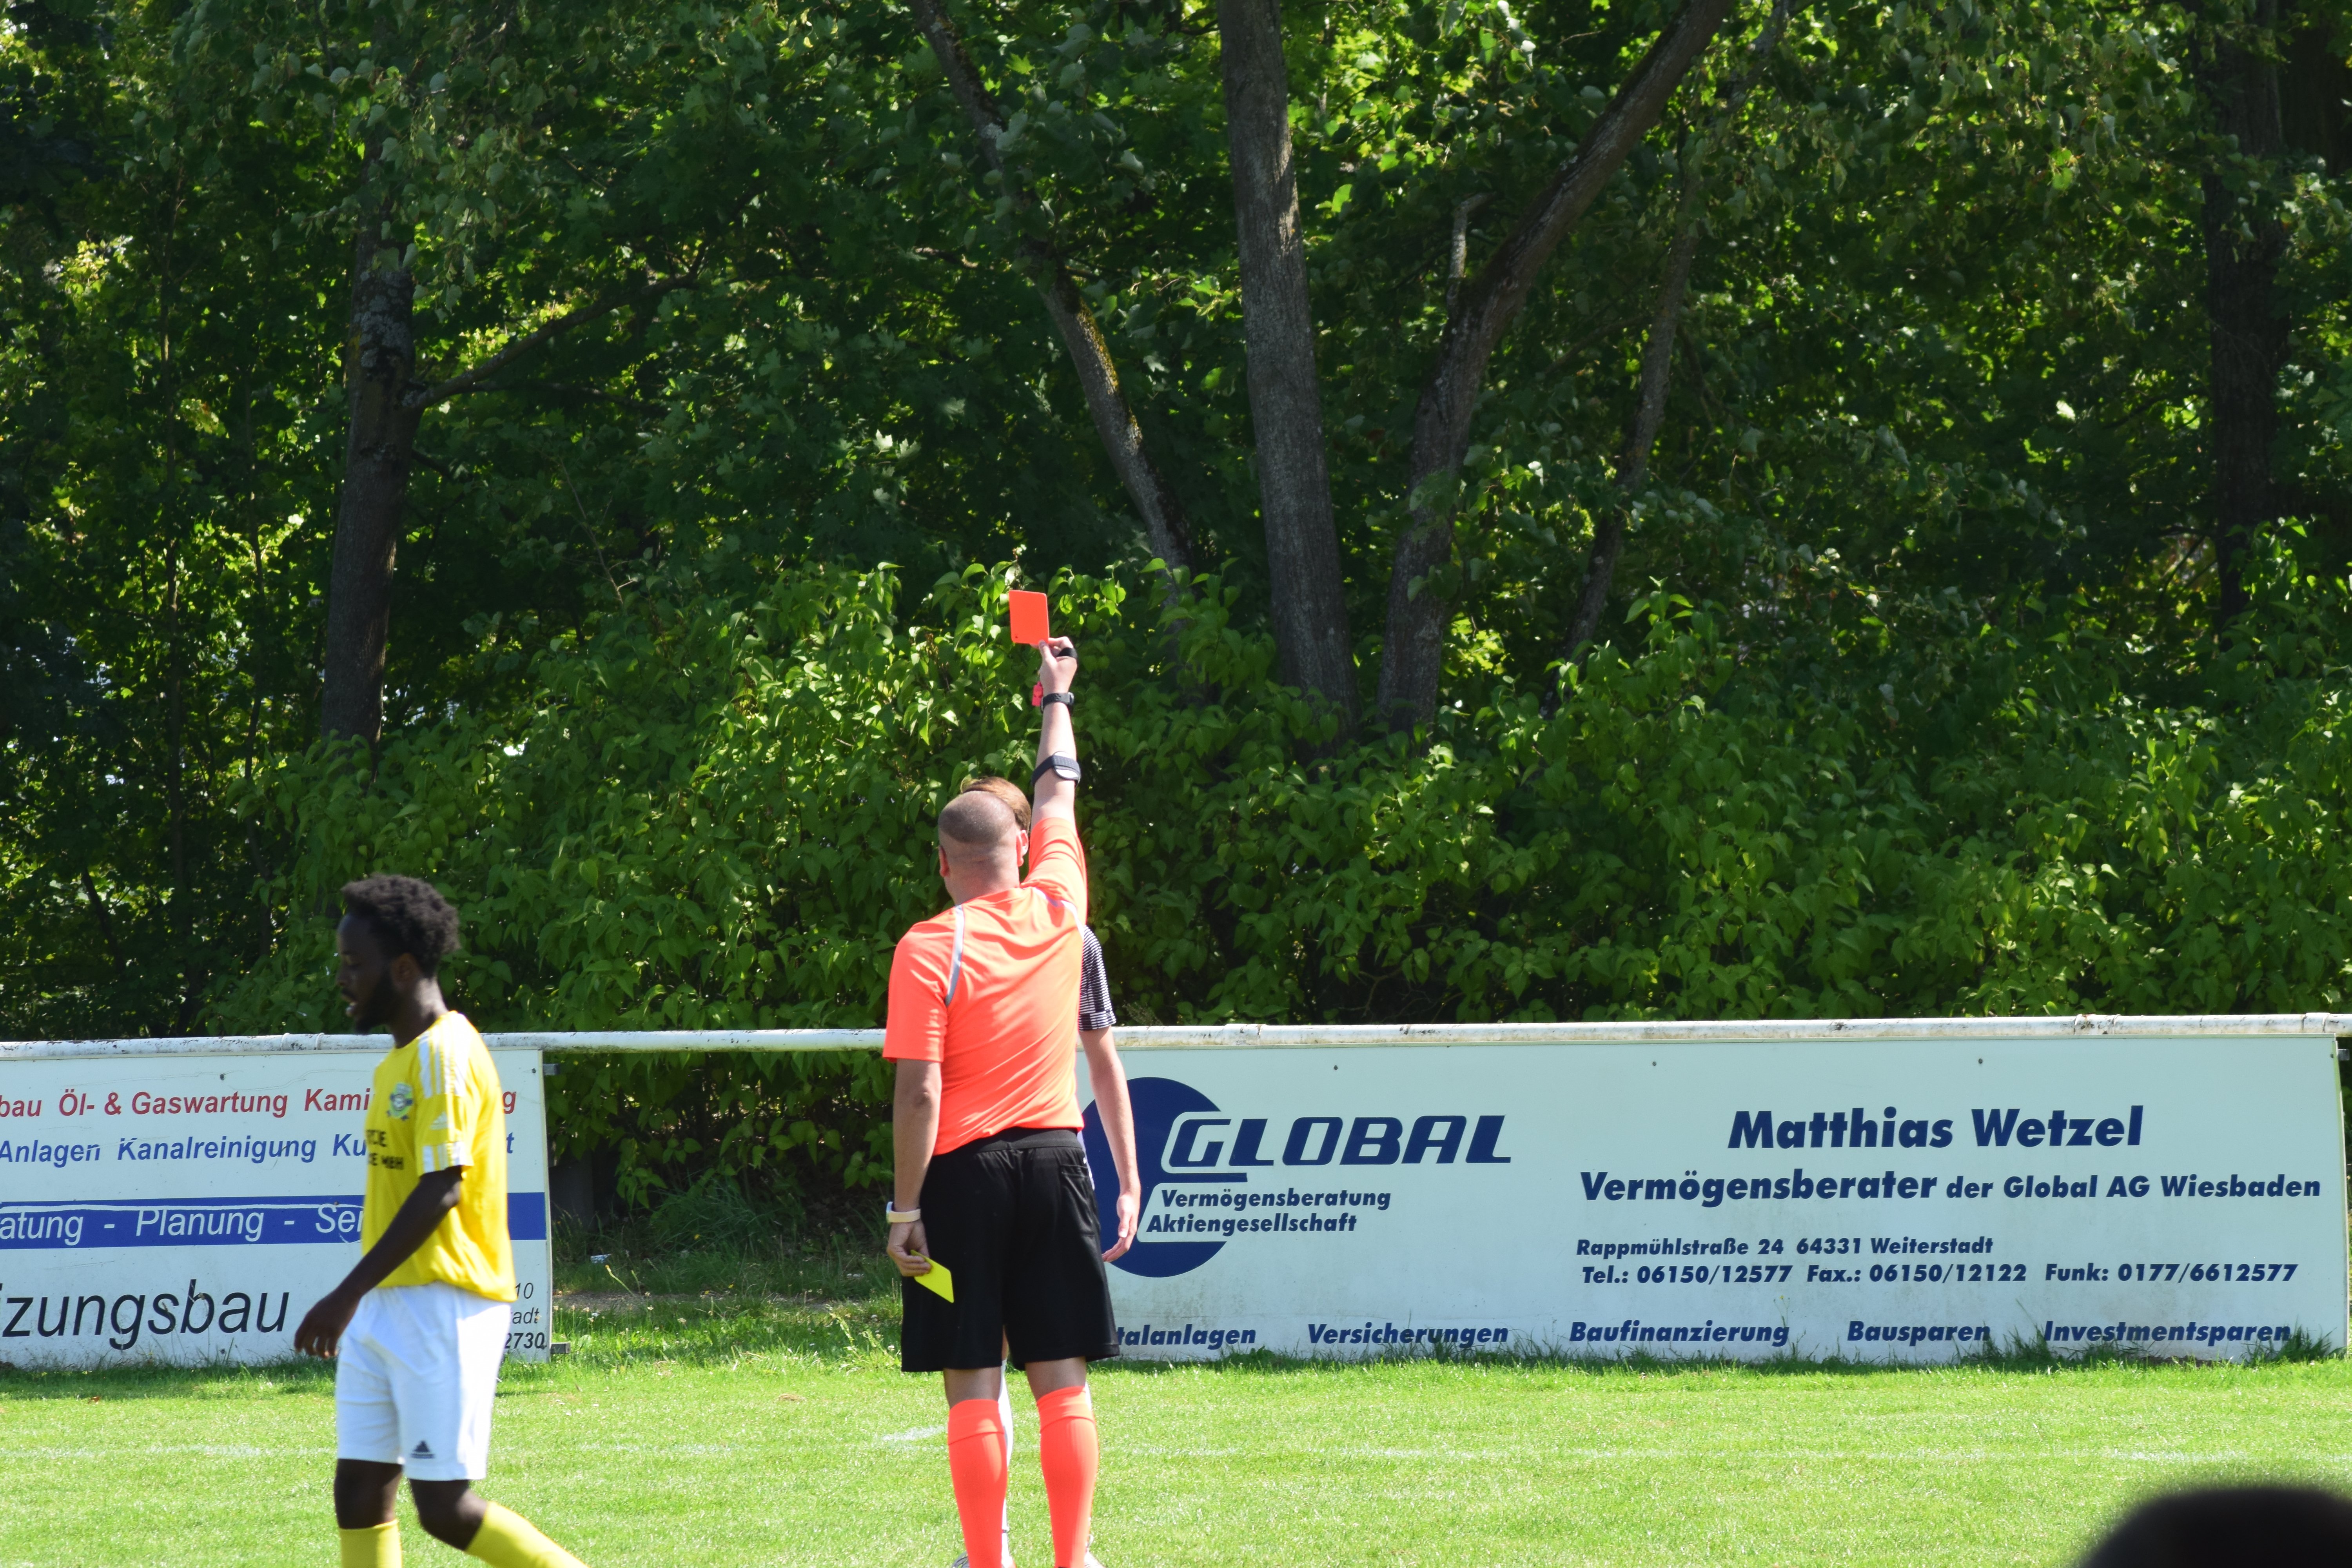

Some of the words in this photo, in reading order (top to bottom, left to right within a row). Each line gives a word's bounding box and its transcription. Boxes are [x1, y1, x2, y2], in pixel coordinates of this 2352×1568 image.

[59, 1089, 94, 1116] Öl-
[105, 1093, 121, 1115] &
[132, 1091, 287, 1118] Gaswartung
[304, 1089, 375, 1111] Kami
[1169, 1115, 1511, 1167] GLOBAL
[1728, 1107, 1953, 1149] Matthias
[1972, 1105, 2143, 1147] Wetzel
[118, 1136, 316, 1164] Kanalreinigung
[1162, 1188, 1390, 1211] Vermögensberatung
[1581, 1169, 1937, 1207] Vermögensberater
[1947, 1176, 1993, 1198] der
[2004, 1175, 2097, 1198] Global
[2106, 1176, 2149, 1197] AG
[2161, 1174, 2320, 1197] Wiesbaden
[136, 1210, 264, 1242] Planung
[1146, 1213, 1356, 1236] Aktiengesellschaft
[1577, 1238, 1748, 1259] Rappmühlstraße
[1758, 1239, 1783, 1254] 24
[1797, 1238, 1860, 1254] 64331
[1871, 1236, 1993, 1254] Weiterstadt
[1583, 1265, 1628, 1283] Tel.:
[1637, 1265, 1793, 1285] 06150/12577
[1808, 1265, 1860, 1282] Fax.:
[1870, 1264, 2026, 1283] 06150/12122
[2046, 1263, 2108, 1281] Funk:
[2118, 1263, 2298, 1283] 0177/6612577
[0, 1279, 289, 1350] zungsbau
[1308, 1323, 1508, 1348] Versicherungen
[1569, 1320, 1789, 1346] Baufinanzierung
[1847, 1321, 1990, 1346] Bausparen
[2044, 1321, 2291, 1347] Investmentsparen
